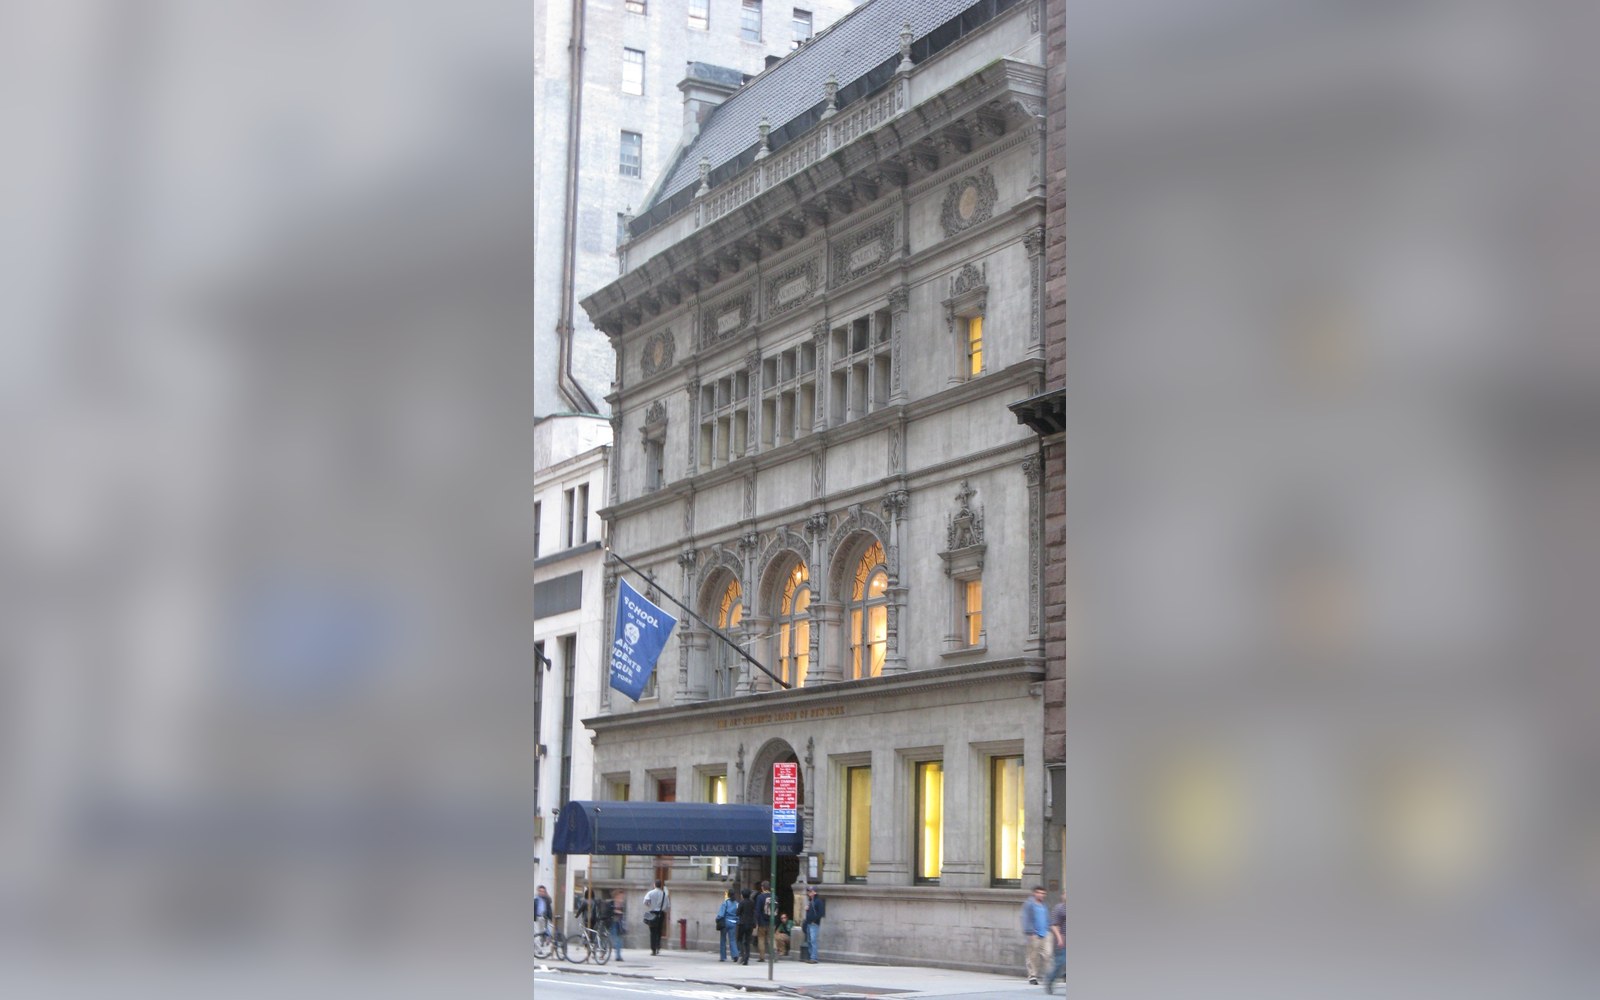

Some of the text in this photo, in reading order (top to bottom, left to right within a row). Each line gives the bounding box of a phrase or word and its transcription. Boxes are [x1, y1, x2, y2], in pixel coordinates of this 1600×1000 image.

[623, 596, 659, 628] SCHOOL
[627, 612, 646, 629] OF THE
[615, 638, 635, 656] ART
[615, 843, 633, 852] THE
[636, 843, 653, 852] ART
[656, 843, 698, 852] STUDENTS
[701, 843, 733, 852] LEAGUE
[736, 844, 748, 852] OF
[750, 843, 768, 852] NEW
[776, 844, 793, 852] ORK
